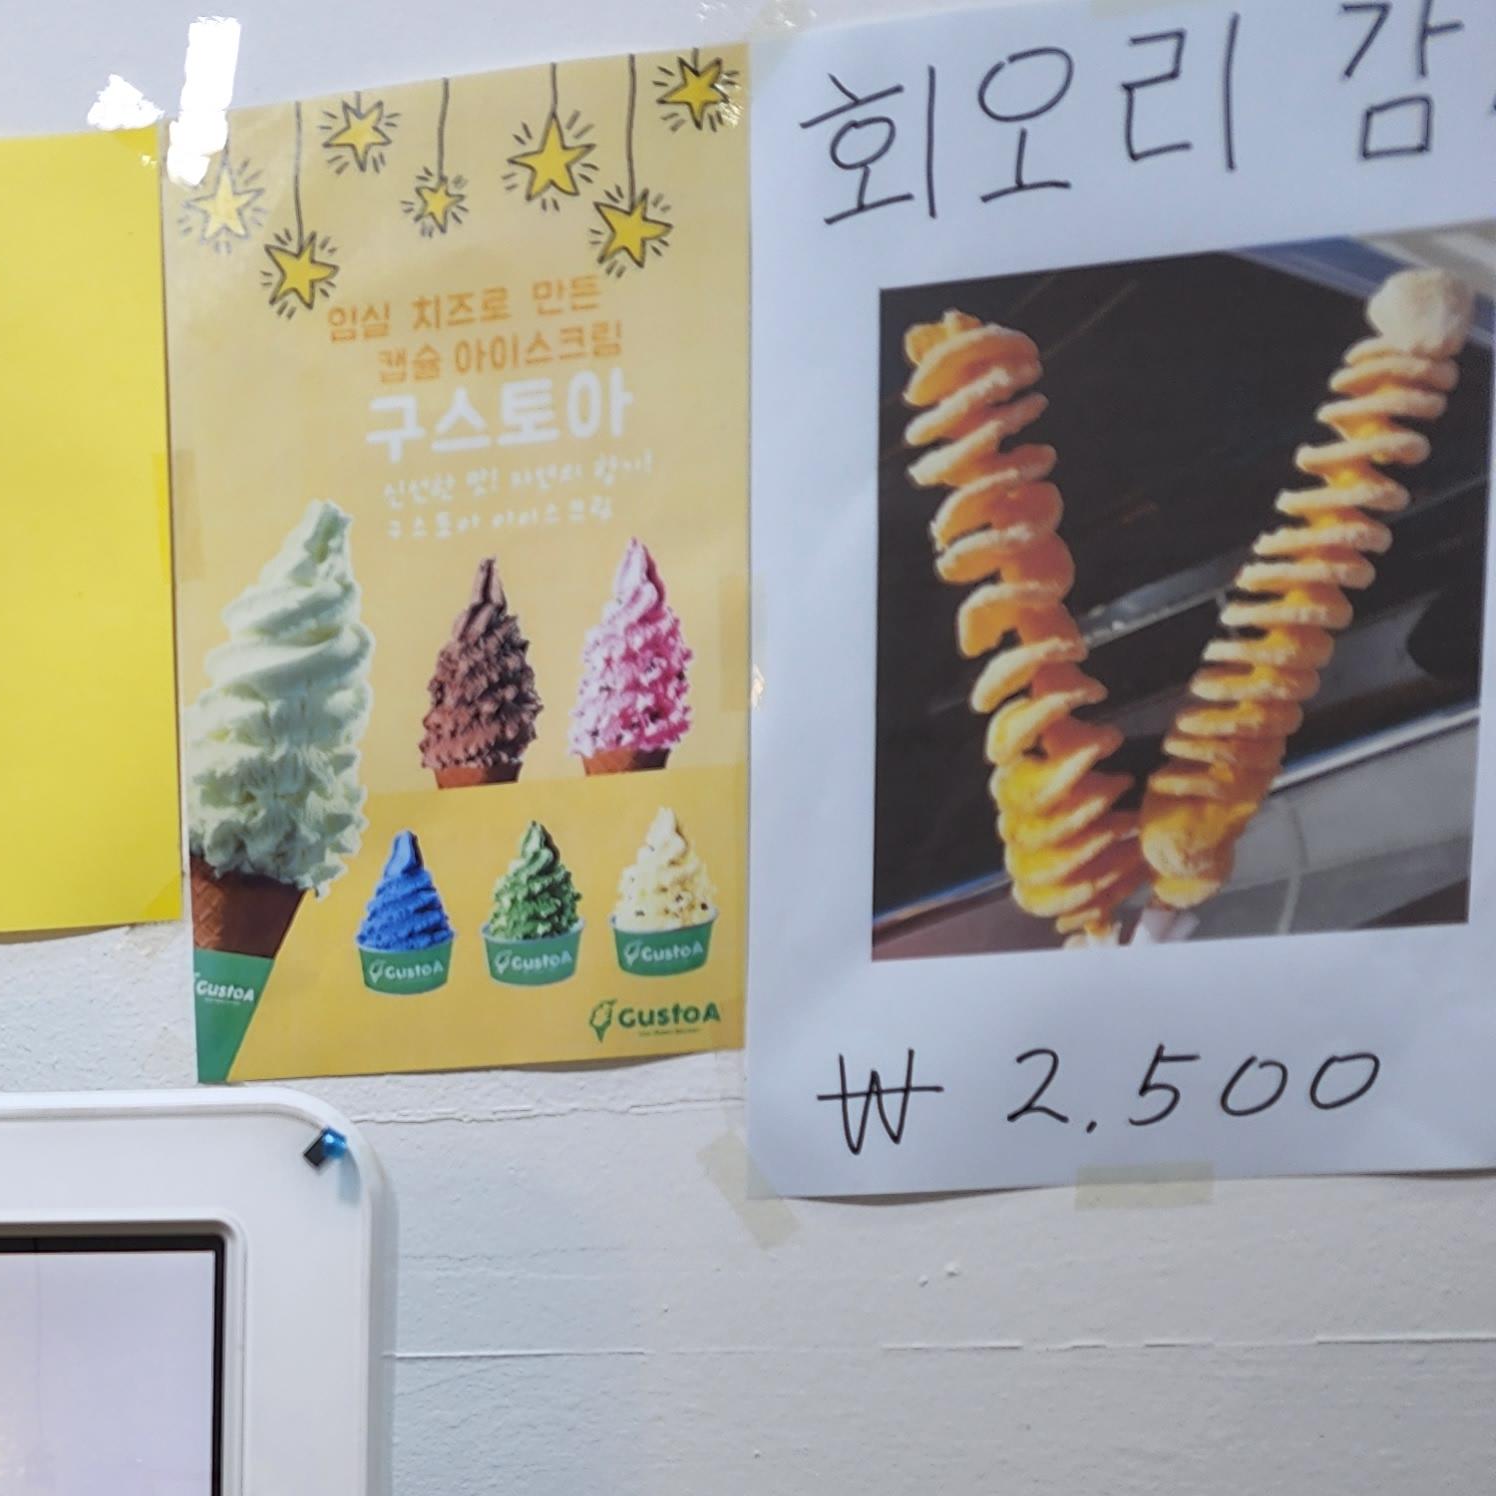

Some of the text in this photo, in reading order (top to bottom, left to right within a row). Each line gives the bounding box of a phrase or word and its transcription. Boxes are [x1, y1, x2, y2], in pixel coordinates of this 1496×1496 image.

[799, 0, 1496, 224] 회오리 감
[327, 275, 602, 343] 임실 치즈로 만든
[377, 319, 623, 384] 캡슐 아이스크림
[366, 367, 634, 463] 구스토아
[618, 1002, 721, 1028] GustoA
[1005, 1042, 1381, 1135] 2.500
